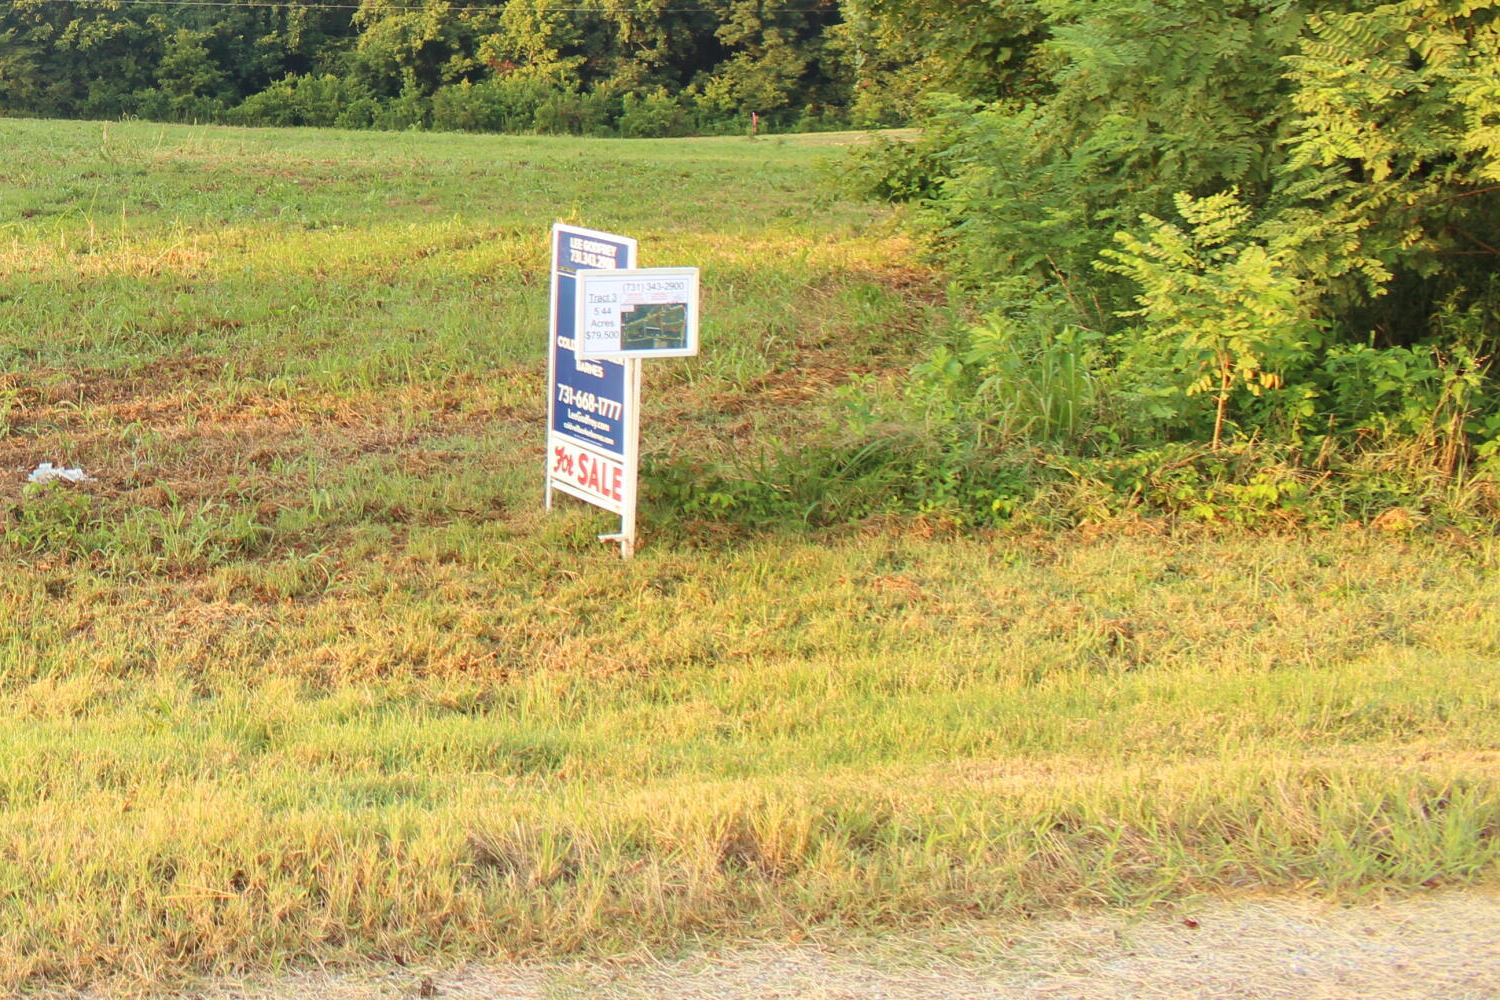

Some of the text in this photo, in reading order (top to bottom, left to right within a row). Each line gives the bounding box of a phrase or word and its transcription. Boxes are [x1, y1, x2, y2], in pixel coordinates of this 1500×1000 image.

[622, 282, 684, 295] (731) 343-2900
[588, 293, 610, 303] Tract
[590, 319, 614, 328] Acres
[557, 383, 622, 421] 731-668-1777
[553, 445, 623, 503] For SALE
